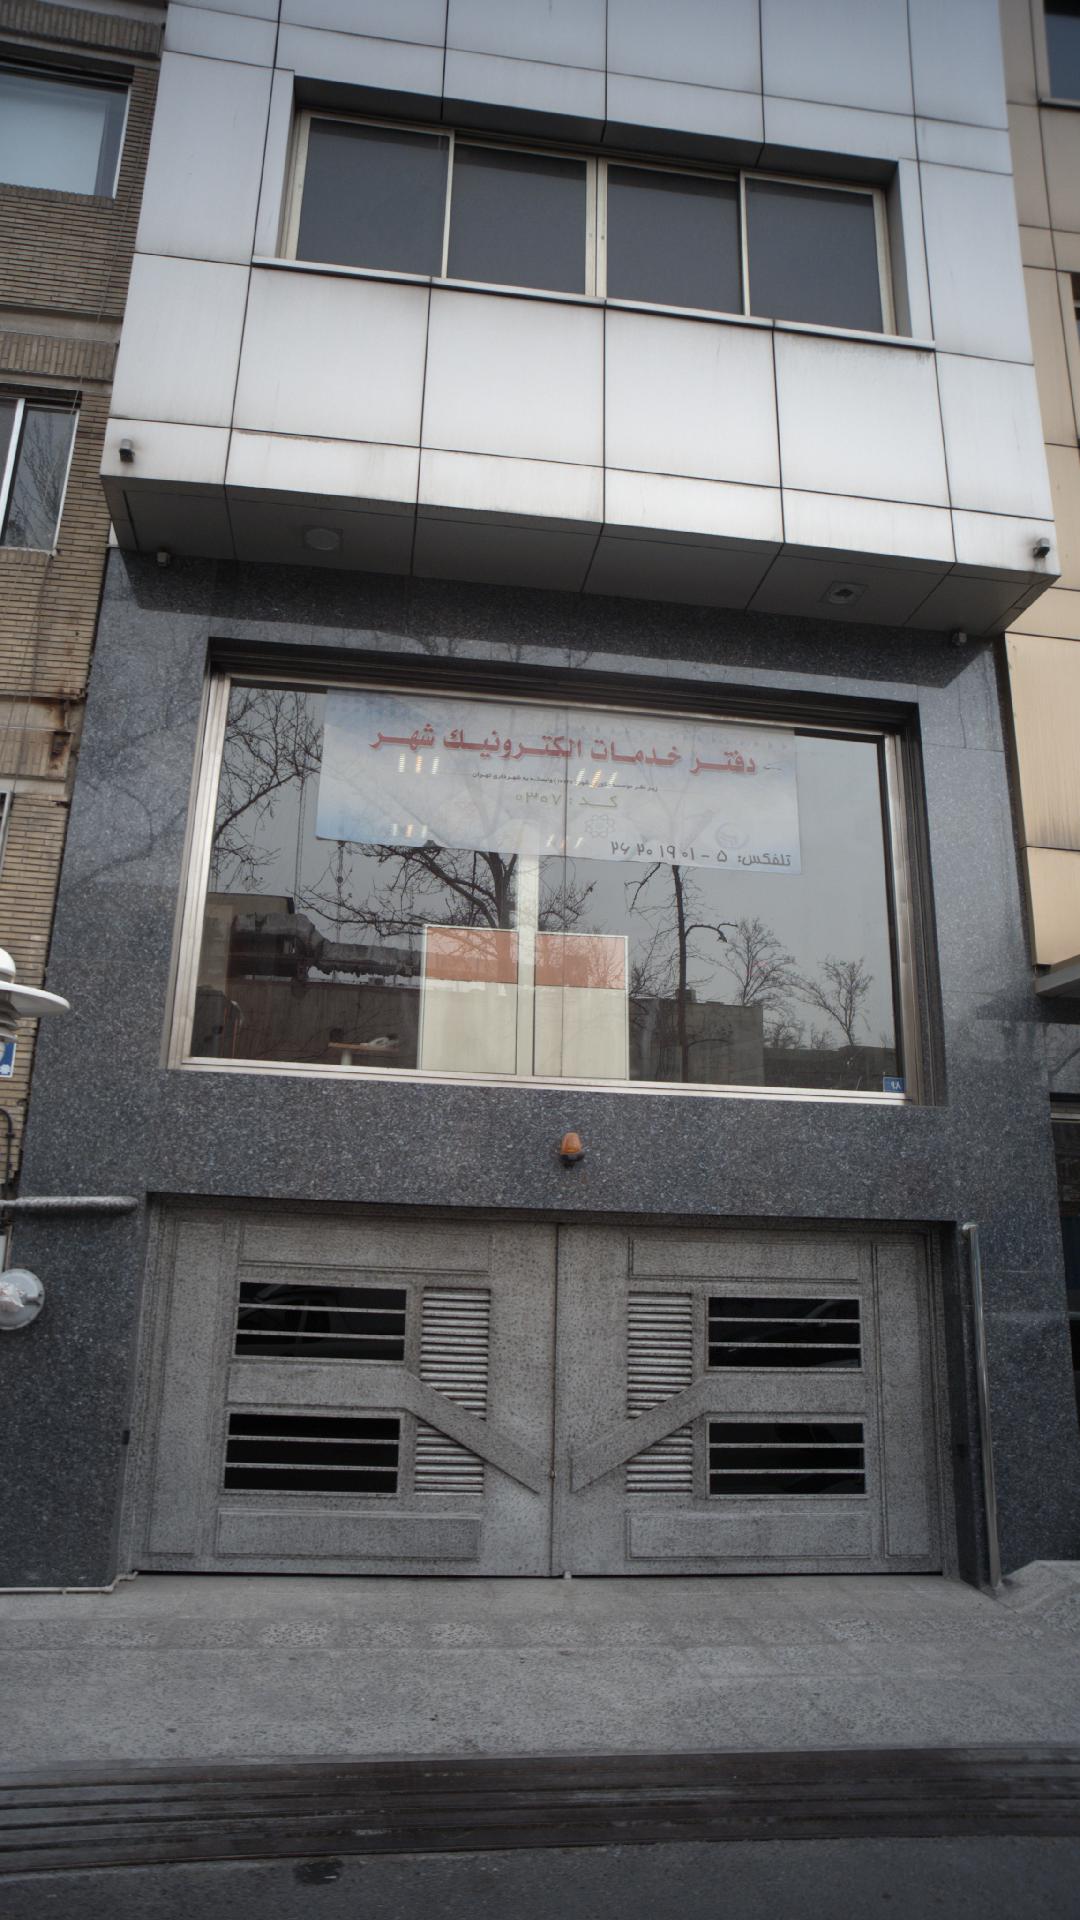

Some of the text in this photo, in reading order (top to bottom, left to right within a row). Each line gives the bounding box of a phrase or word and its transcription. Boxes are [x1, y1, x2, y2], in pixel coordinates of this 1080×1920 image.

[368, 722, 436, 753] شهر
[591, 739, 682, 766] خدمات
[689, 750, 756, 775] دفتر
